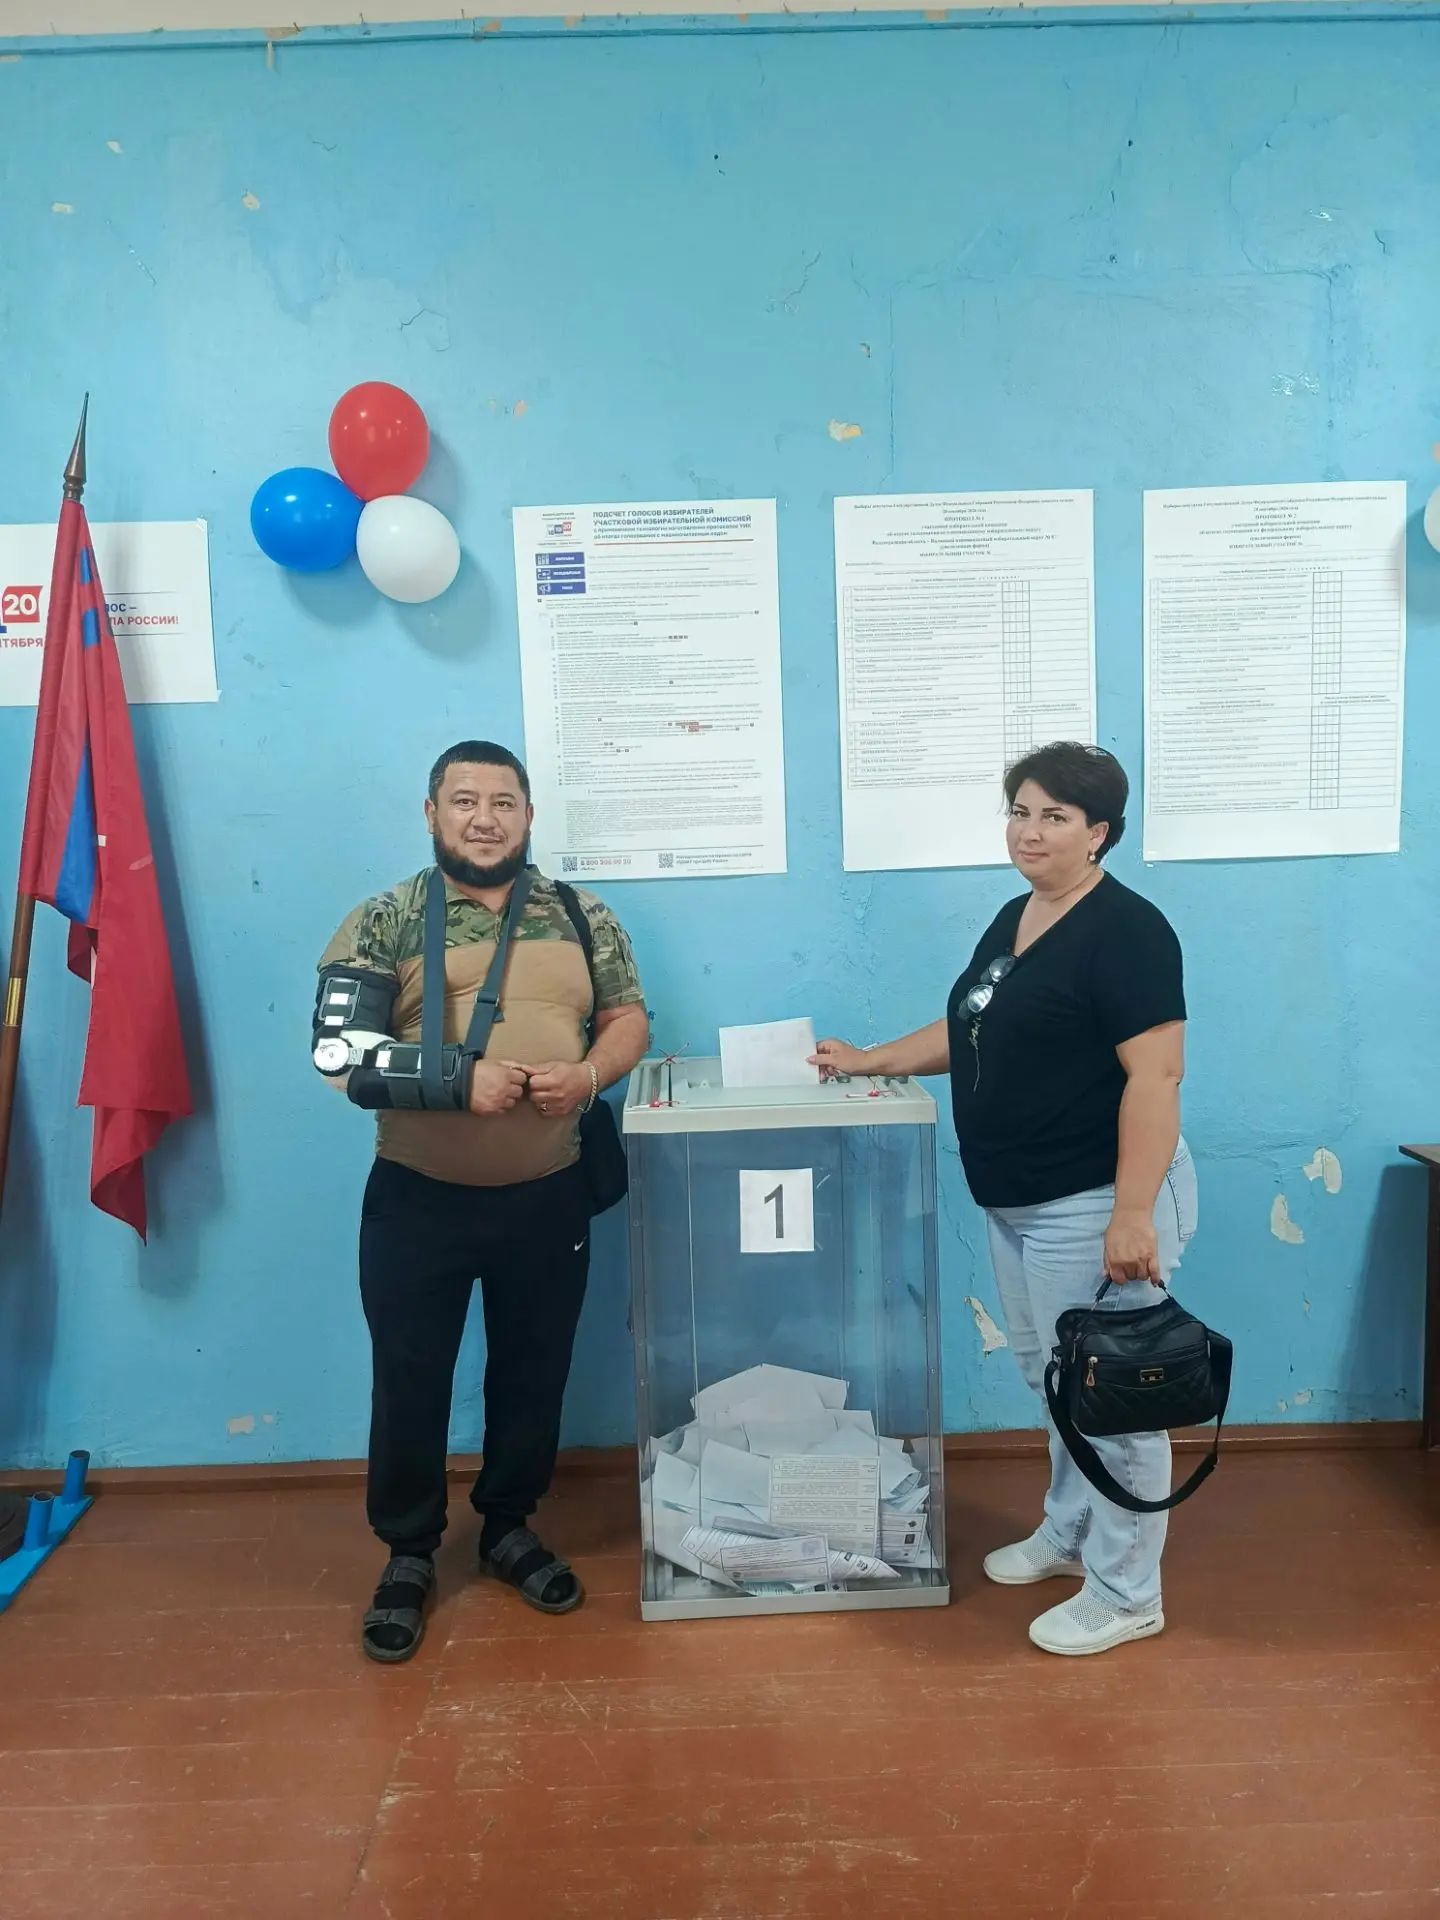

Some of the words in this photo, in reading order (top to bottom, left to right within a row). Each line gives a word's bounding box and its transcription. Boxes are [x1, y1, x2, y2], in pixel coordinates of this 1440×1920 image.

[663, 507, 714, 516] ИЗБИРАТЕЛЕЙ
[593, 518, 641, 526] УЧАСТКОВОЙ
[643, 516, 705, 525] ИЗБИРАТЕЛЬНОЙ
[707, 514, 751, 523] КОМИССИЕЙ
[4, 594, 37, 616] 20
[128, 616, 179, 625] РОССИИ!
[764, 1184, 784, 1238] 1
